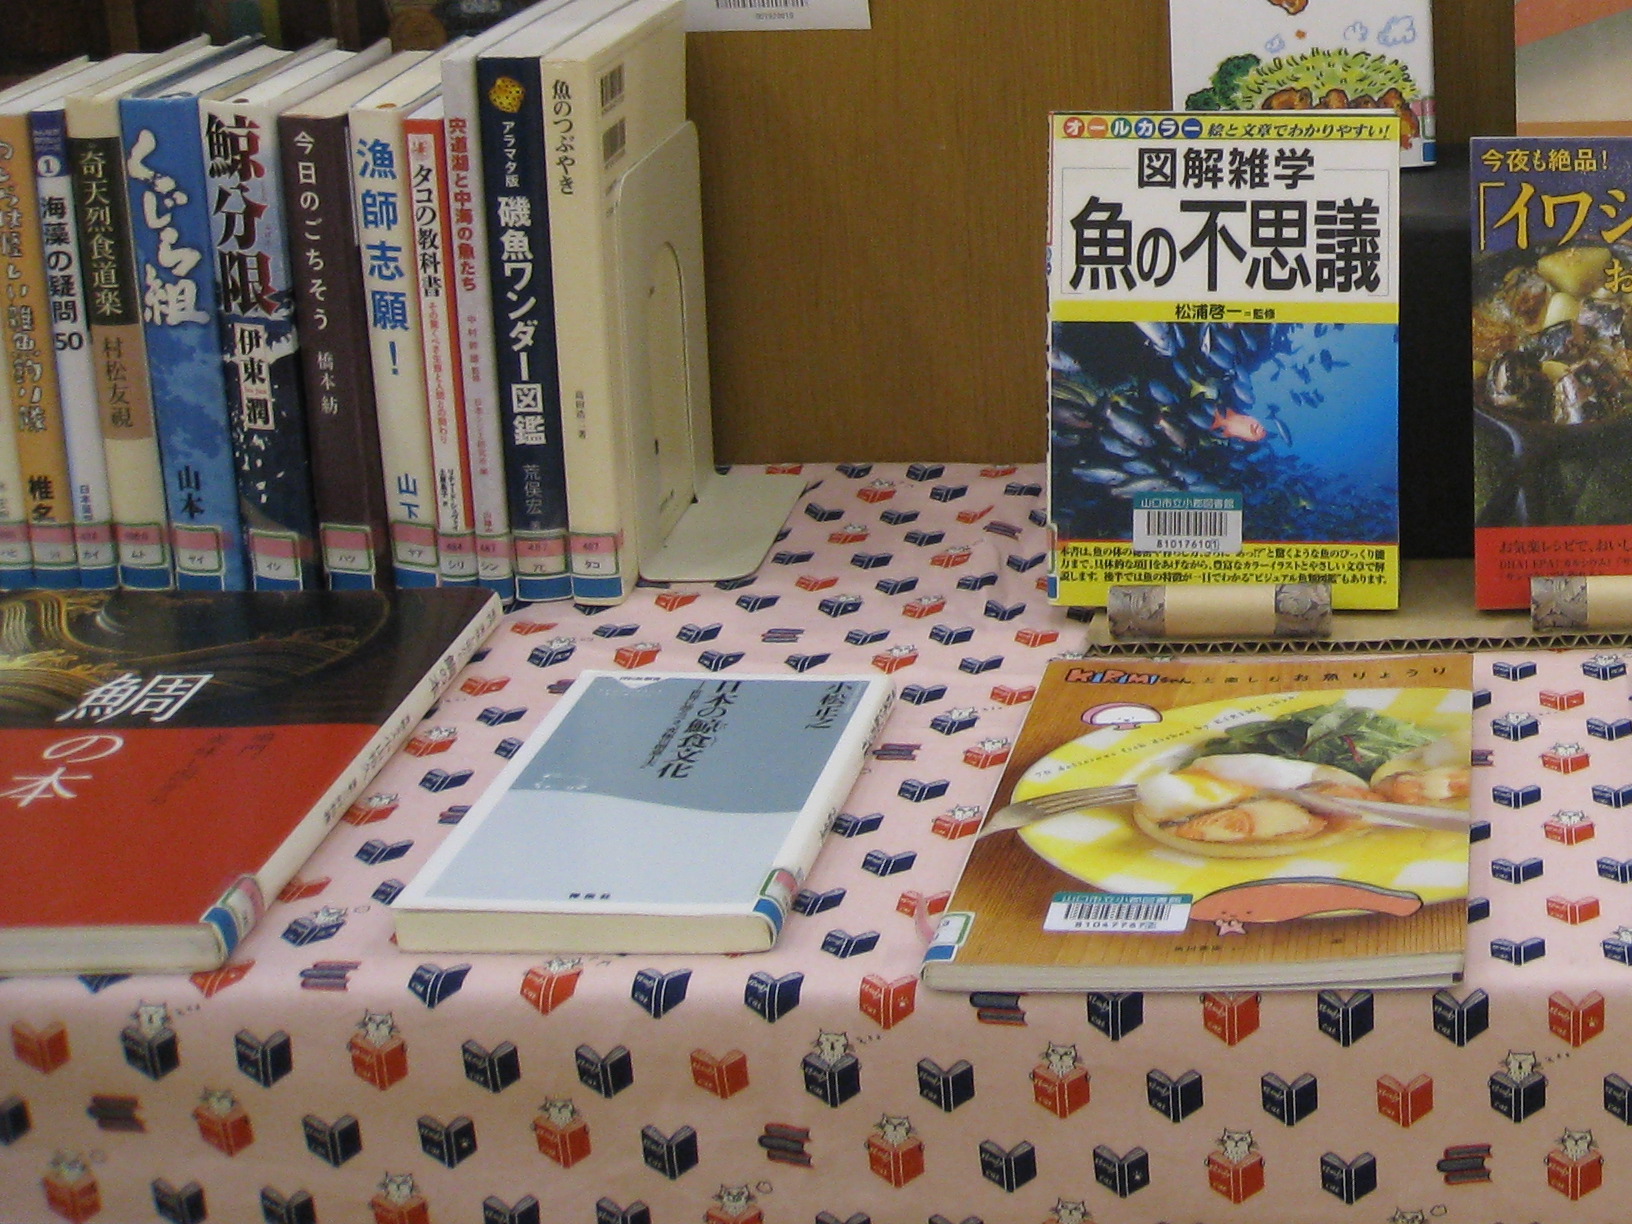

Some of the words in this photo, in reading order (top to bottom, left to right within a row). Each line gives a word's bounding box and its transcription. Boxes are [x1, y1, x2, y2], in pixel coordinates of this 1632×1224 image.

[501, 121, 521, 188] アラマタ版
[550, 78, 575, 197] 魚のつぶやき
[1063, 117, 1203, 139] オールカラー
[1138, 147, 1316, 190] 図解雑学
[40, 196, 85, 350] 海藻の疑問50
[79, 149, 123, 316] 奇天烈食道楽
[127, 127, 211, 327] くじら組
[204, 112, 282, 317] 鯨分限
[293, 130, 331, 332] 今日のごちそう
[411, 163, 443, 298] タコの教科書
[1069, 195, 1382, 293] 魚の不思議
[497, 196, 547, 446] 磯魚ワンダー図鑑
[178, 465, 205, 520] 山本
[397, 473, 419, 519] 山下
[521, 464, 544, 515] 荒俣宏
[0, 672, 215, 808] 鯛の本
